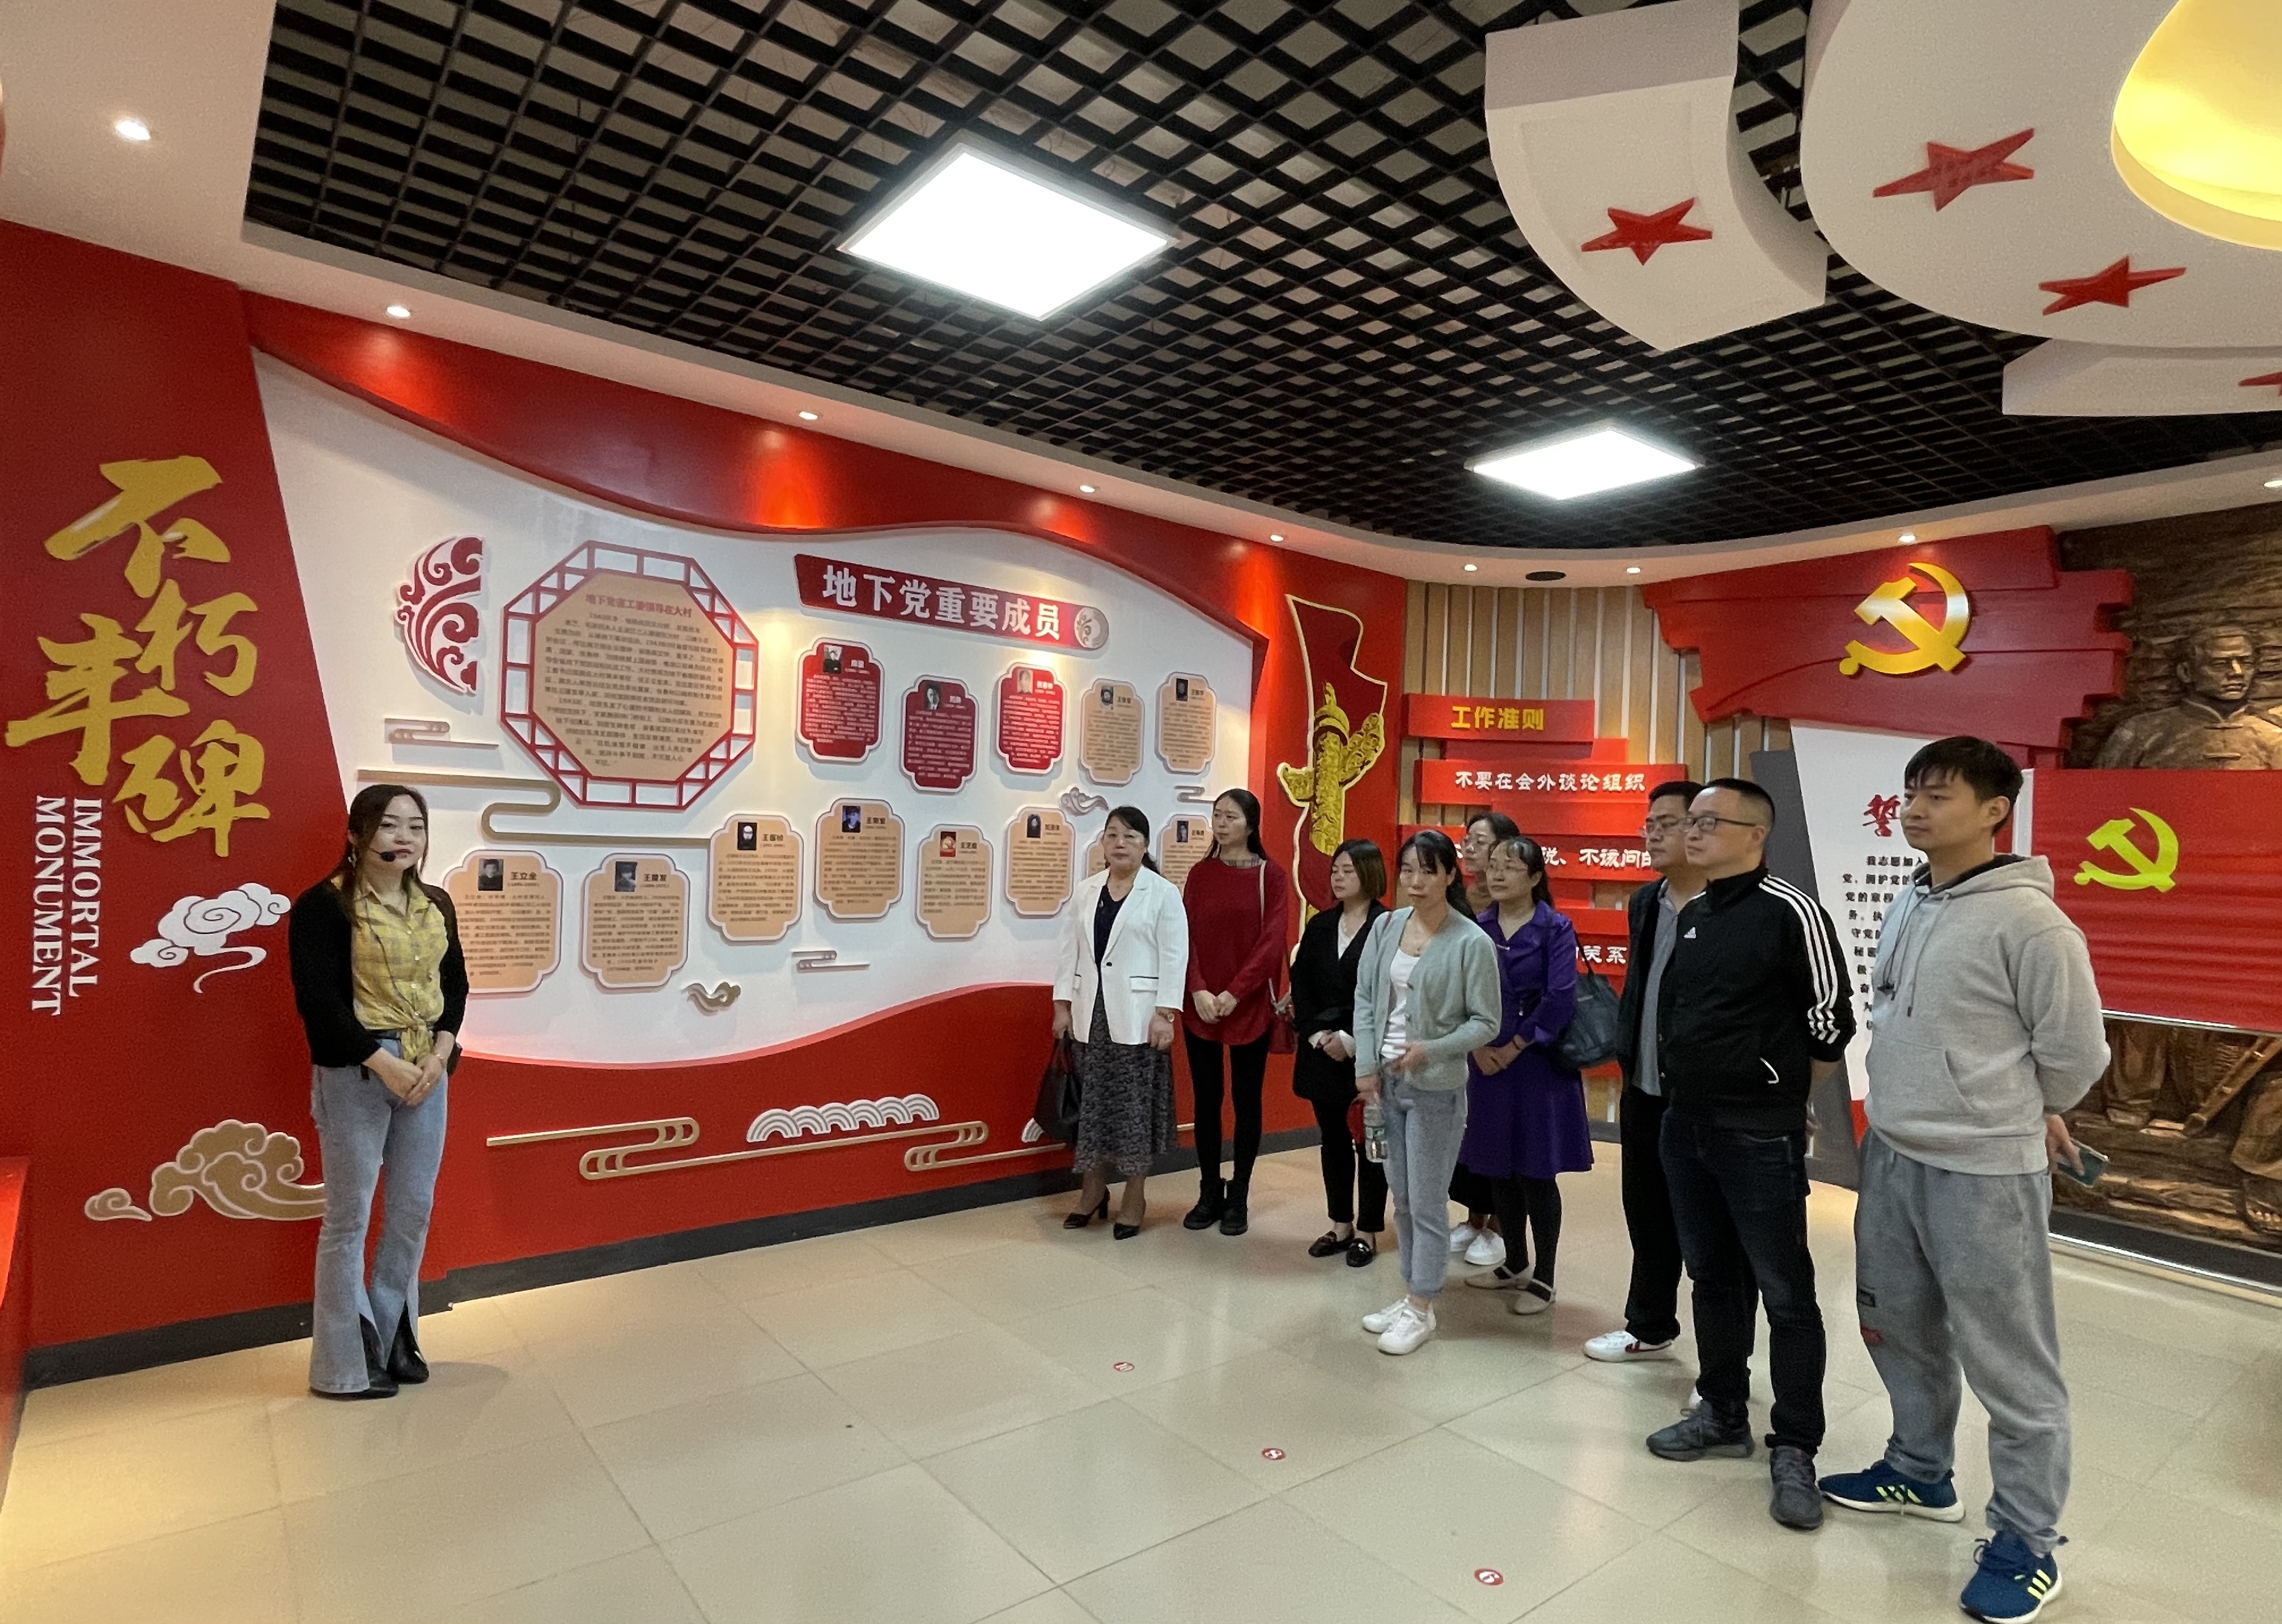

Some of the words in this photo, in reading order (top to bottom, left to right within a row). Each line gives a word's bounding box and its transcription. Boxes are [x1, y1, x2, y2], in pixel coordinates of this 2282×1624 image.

[822, 564, 1061, 641] 地下党重要成员
[1450, 705, 1545, 730] 工作准则
[1454, 771, 1646, 792] 不要在会外谈论组织
[31, 794, 66, 1016] MONUMENT
[69, 798, 103, 997] IMMORTAL
[1576, 946, 1627, 964] 关系
